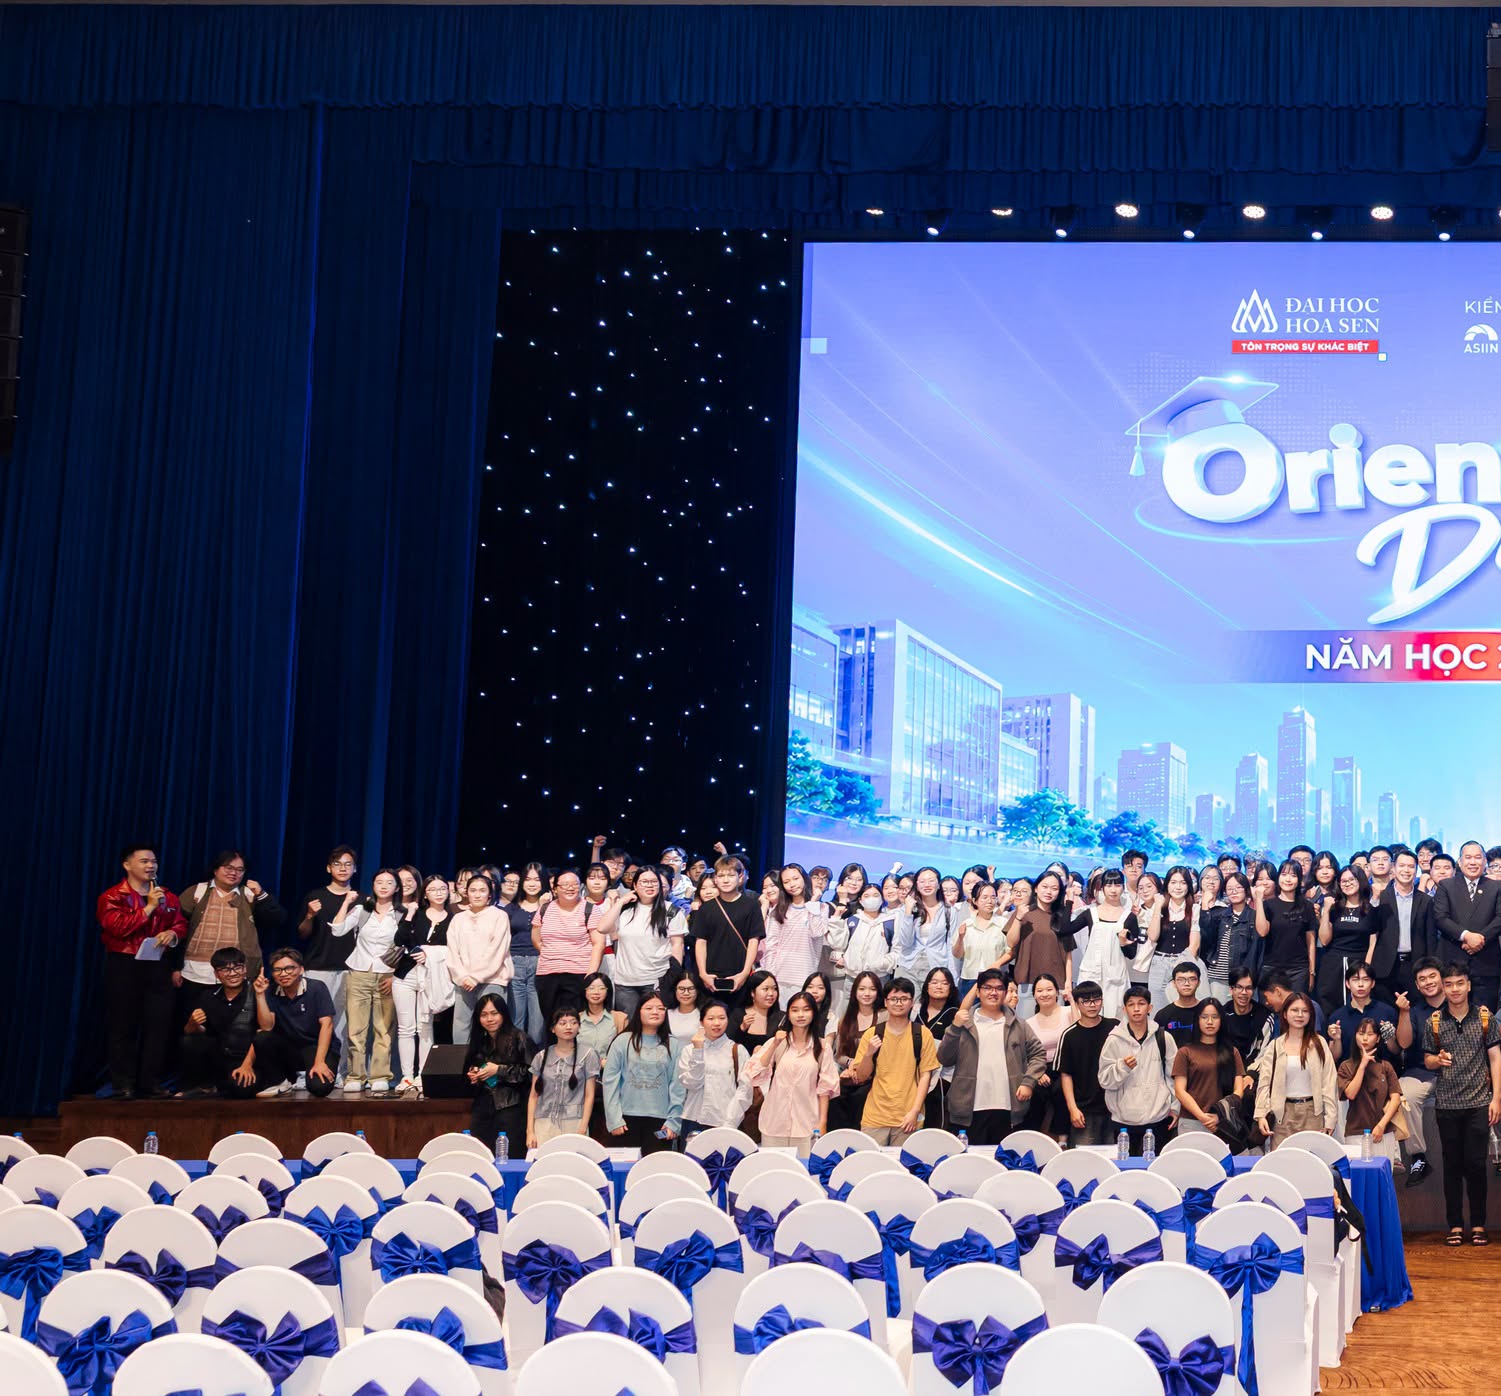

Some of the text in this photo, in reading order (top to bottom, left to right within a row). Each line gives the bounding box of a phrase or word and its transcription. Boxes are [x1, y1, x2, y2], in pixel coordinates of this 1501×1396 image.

[1285, 297, 1380, 315] ĐẠI HỌC
[1285, 318, 1380, 334] HOA SEN
[1241, 341, 1369, 353] TÔN TRỌNG SỰ KHÁC BIỆT
[1463, 343, 1499, 353] ASIIN
[1305, 637, 1392, 670] NĂM
[1405, 643, 1488, 677] HỌC
